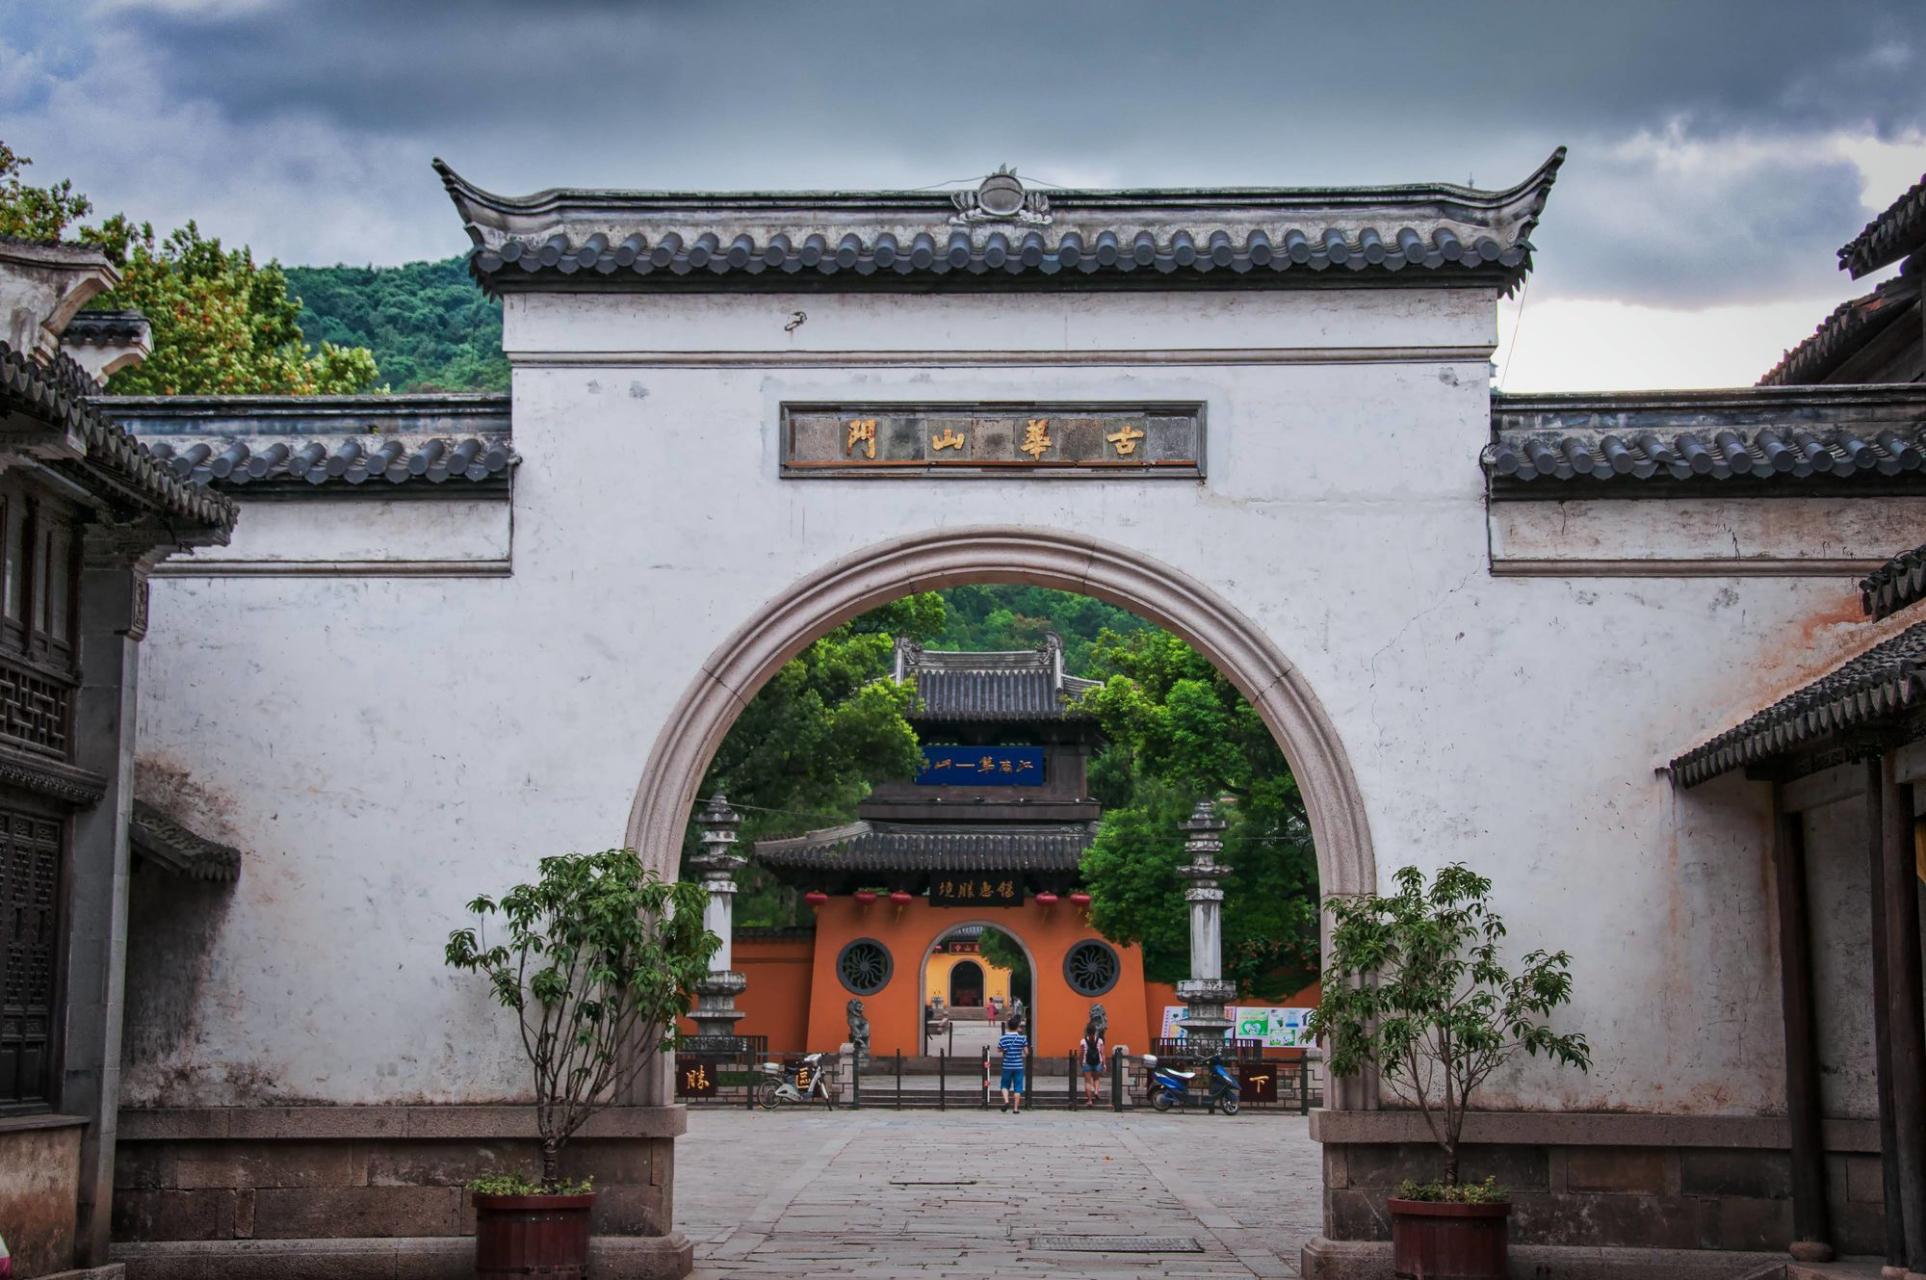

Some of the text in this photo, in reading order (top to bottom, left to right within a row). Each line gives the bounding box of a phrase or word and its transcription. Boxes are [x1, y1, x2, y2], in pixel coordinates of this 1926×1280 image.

[846, 418, 1145, 461] 古華山門
[1249, 1075, 1270, 1094] 下
